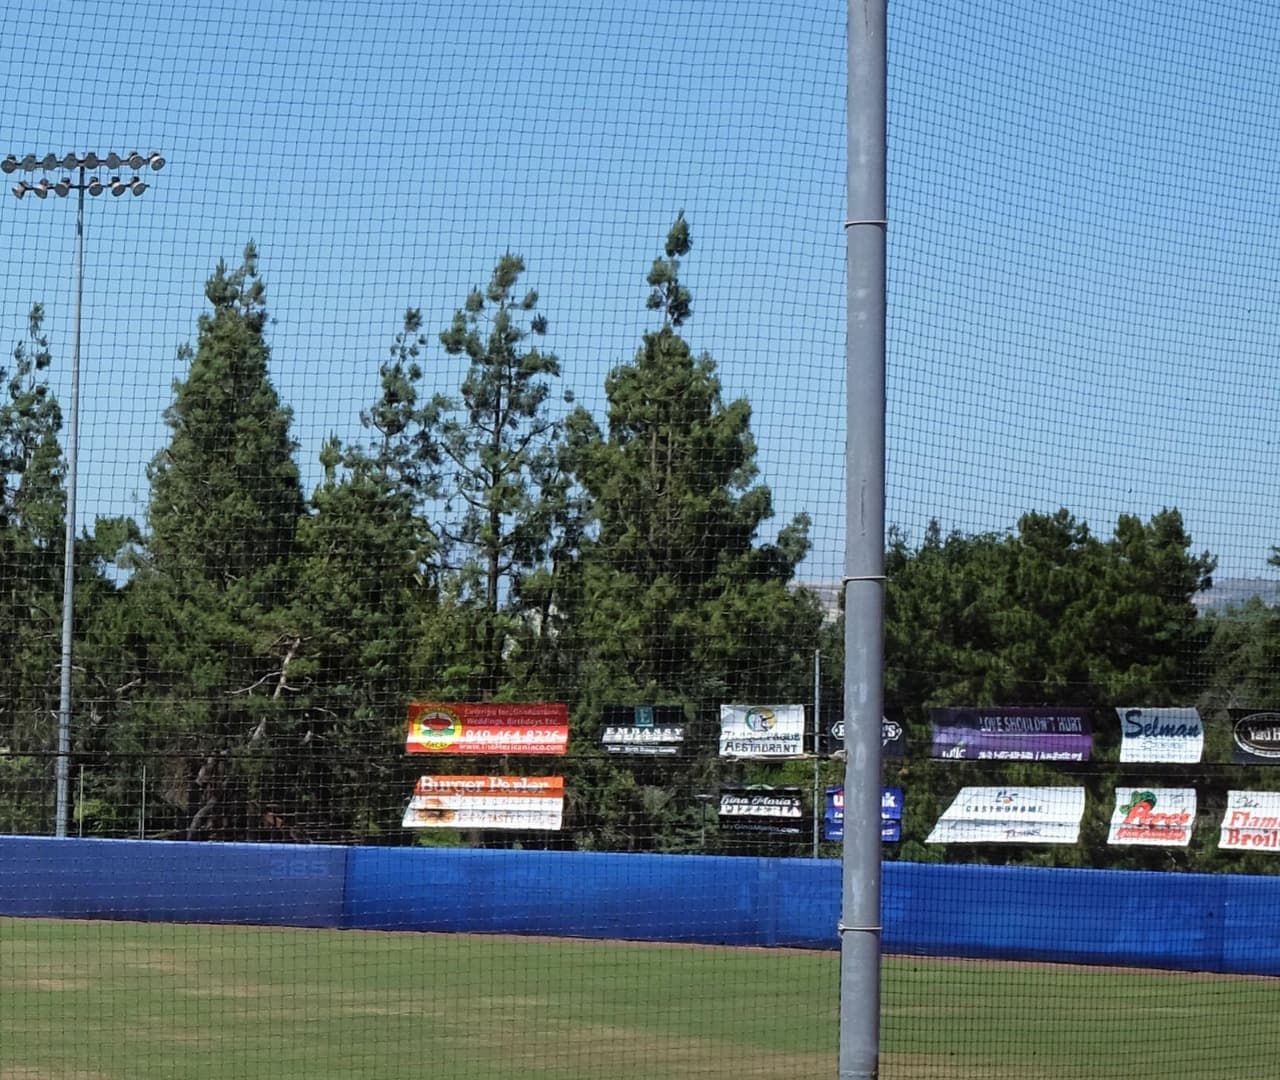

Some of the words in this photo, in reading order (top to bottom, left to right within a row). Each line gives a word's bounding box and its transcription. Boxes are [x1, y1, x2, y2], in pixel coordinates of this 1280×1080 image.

[606, 727, 684, 736] EMBASSY
[980, 716, 1002, 732] LOVE
[1057, 716, 1082, 731] HURT
[1125, 710, 1200, 739] Selman
[724, 741, 797, 753] RESTAURANT
[420, 776, 485, 796] Burger
[488, 776, 550, 794] Parlor
[719, 804, 802, 818] PIZZERIA
[1227, 828, 1280, 848] Broil
